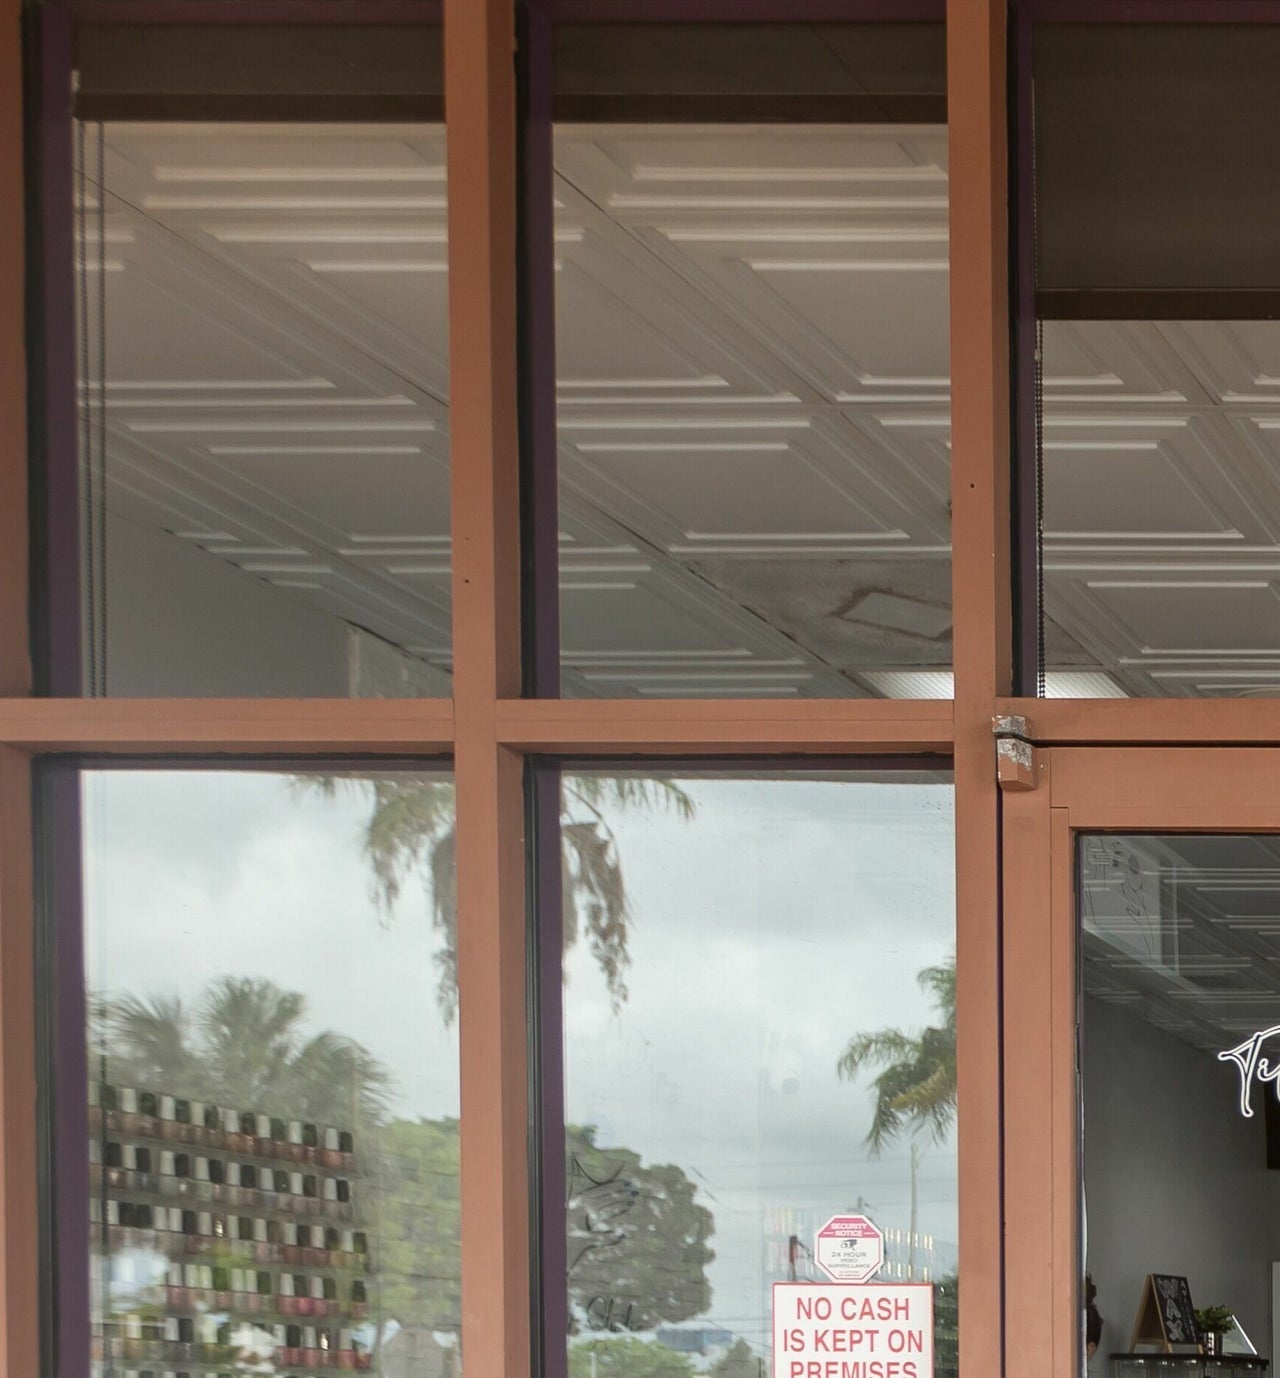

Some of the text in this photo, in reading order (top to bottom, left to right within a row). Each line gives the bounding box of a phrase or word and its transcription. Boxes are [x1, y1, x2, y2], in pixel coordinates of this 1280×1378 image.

[796, 1296, 910, 1321] NO CASH
[783, 1328, 923, 1353] IS KEPT ON
